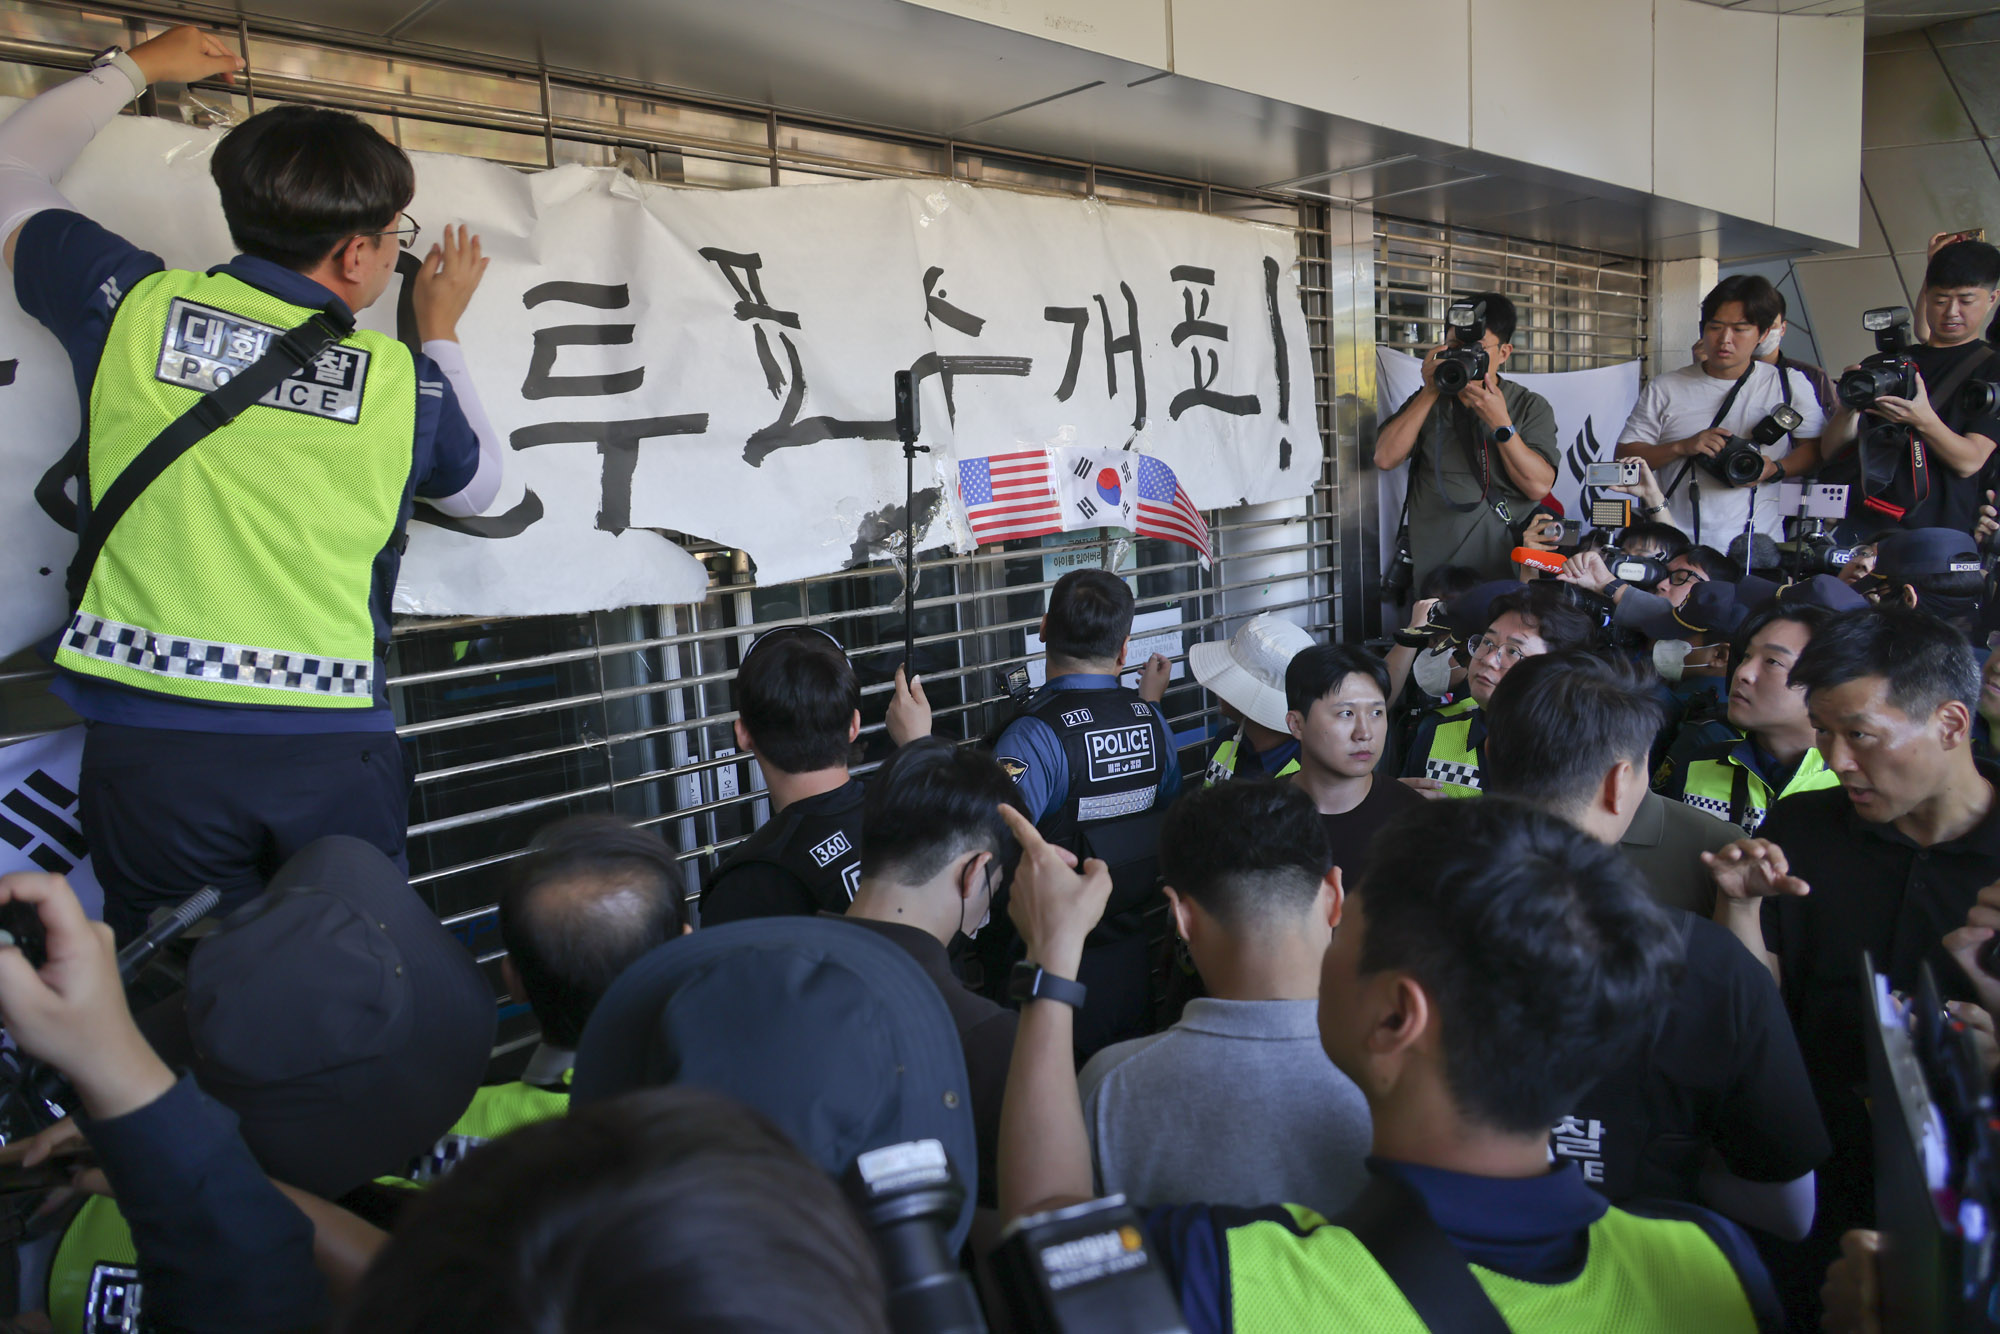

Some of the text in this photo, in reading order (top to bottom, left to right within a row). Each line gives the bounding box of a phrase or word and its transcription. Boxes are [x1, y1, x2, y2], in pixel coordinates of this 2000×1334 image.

[183, 315, 352, 387] 대화찰
[179, 356, 340, 413] POICE
[1915, 441, 1924, 468] Canon
[1956, 563, 1981, 571] POLIC
[1066, 711, 1090, 725] 210
[1092, 729, 1150, 758] POLICE
[816, 836, 846, 863] 360
[1546, 1114, 1606, 1163] 찰
